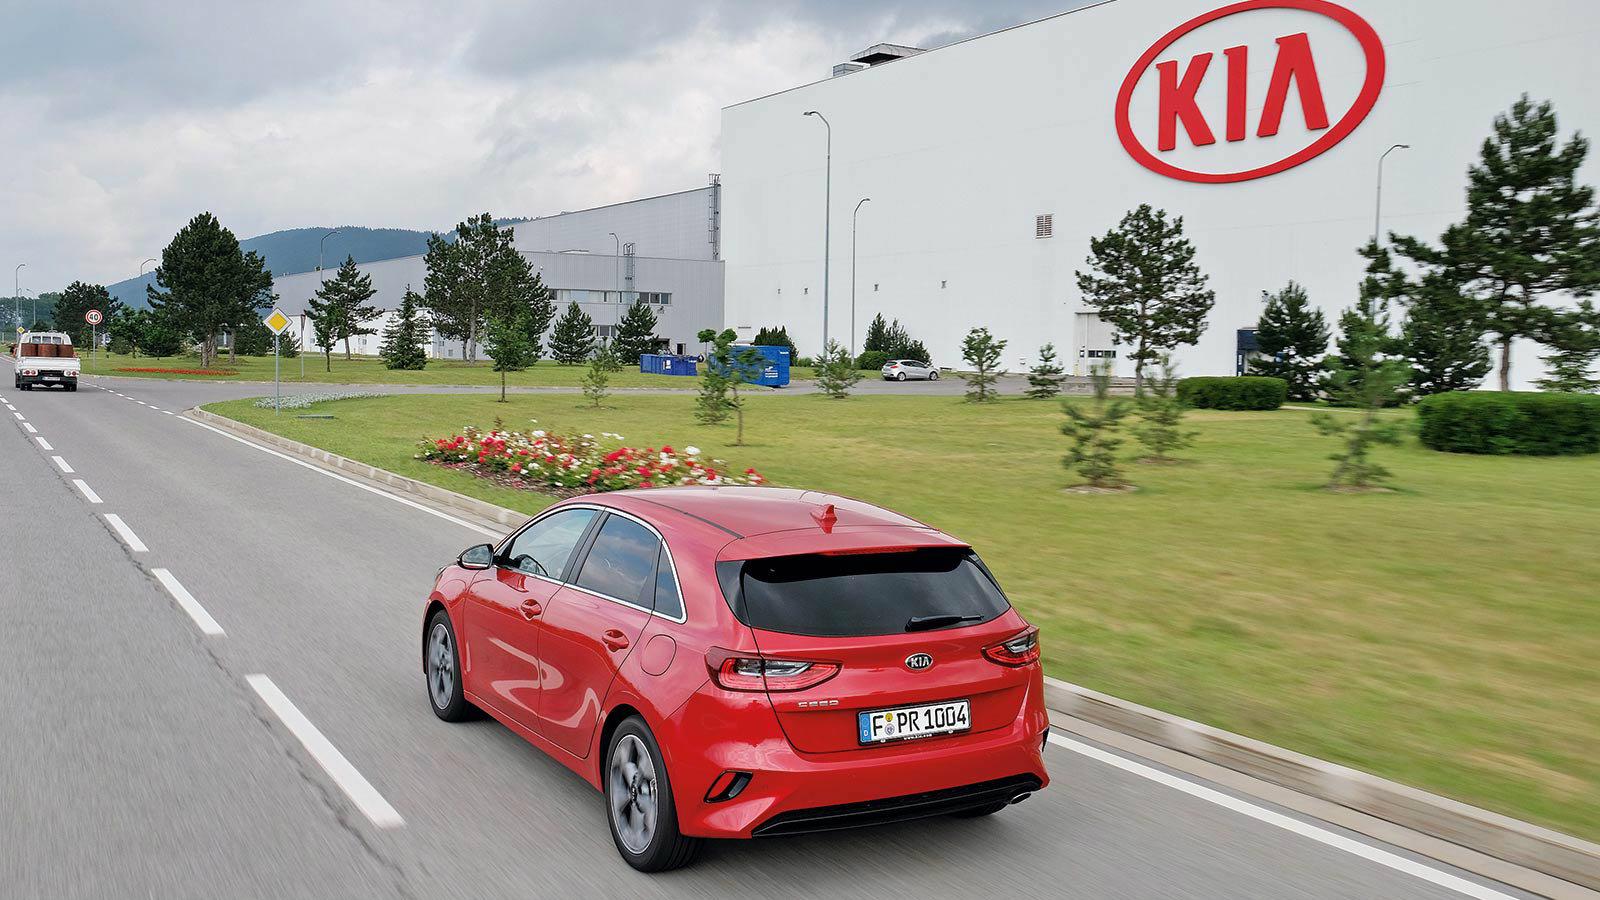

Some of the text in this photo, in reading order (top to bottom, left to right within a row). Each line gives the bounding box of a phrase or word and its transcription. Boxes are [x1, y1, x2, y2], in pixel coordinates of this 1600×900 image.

[1156, 32, 1330, 152] KIA
[89, 313, 99, 321] 40
[910, 656, 930, 668] KIA
[873, 705, 967, 737] F PR 1004
